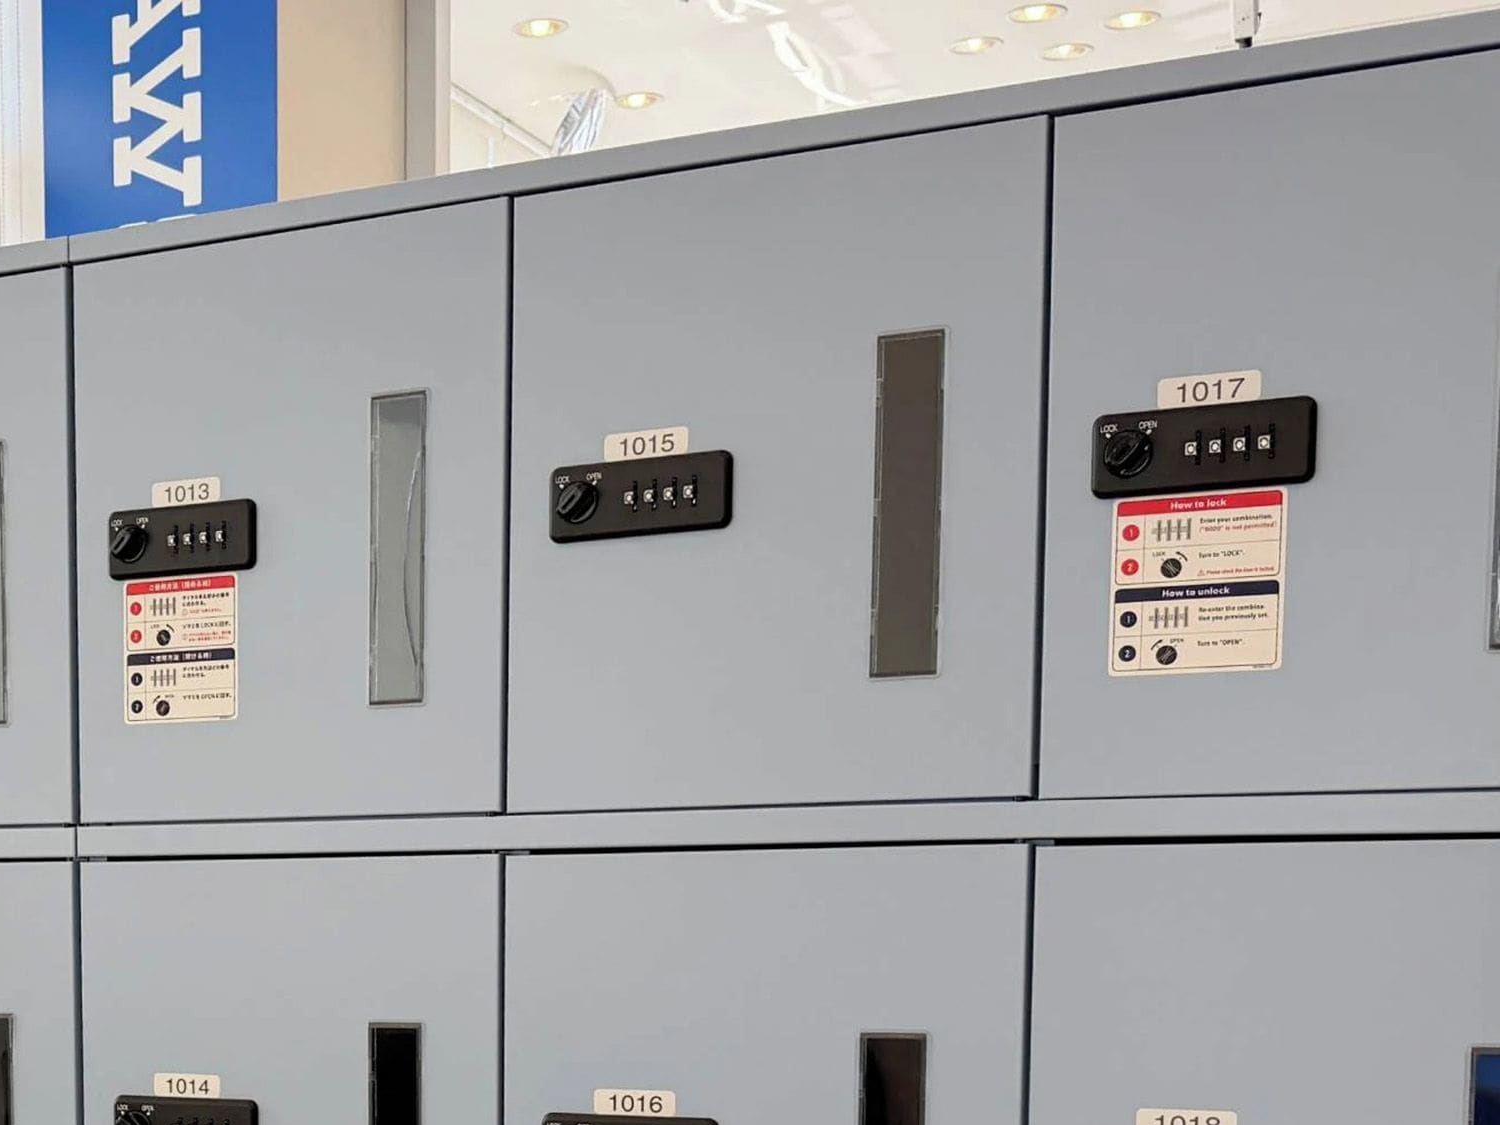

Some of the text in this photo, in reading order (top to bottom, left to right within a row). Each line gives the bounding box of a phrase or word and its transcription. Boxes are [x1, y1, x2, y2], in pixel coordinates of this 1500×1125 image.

[1177, 377, 1245, 403] 1017
[619, 433, 674, 456] 1015
[165, 483, 209, 503] 1013
[1171, 498, 1227, 510] How to lock
[1162, 586, 1230, 598] How to unlock
[166, 1078, 209, 1095] 1014
[609, 1094, 663, 1113] 1016
